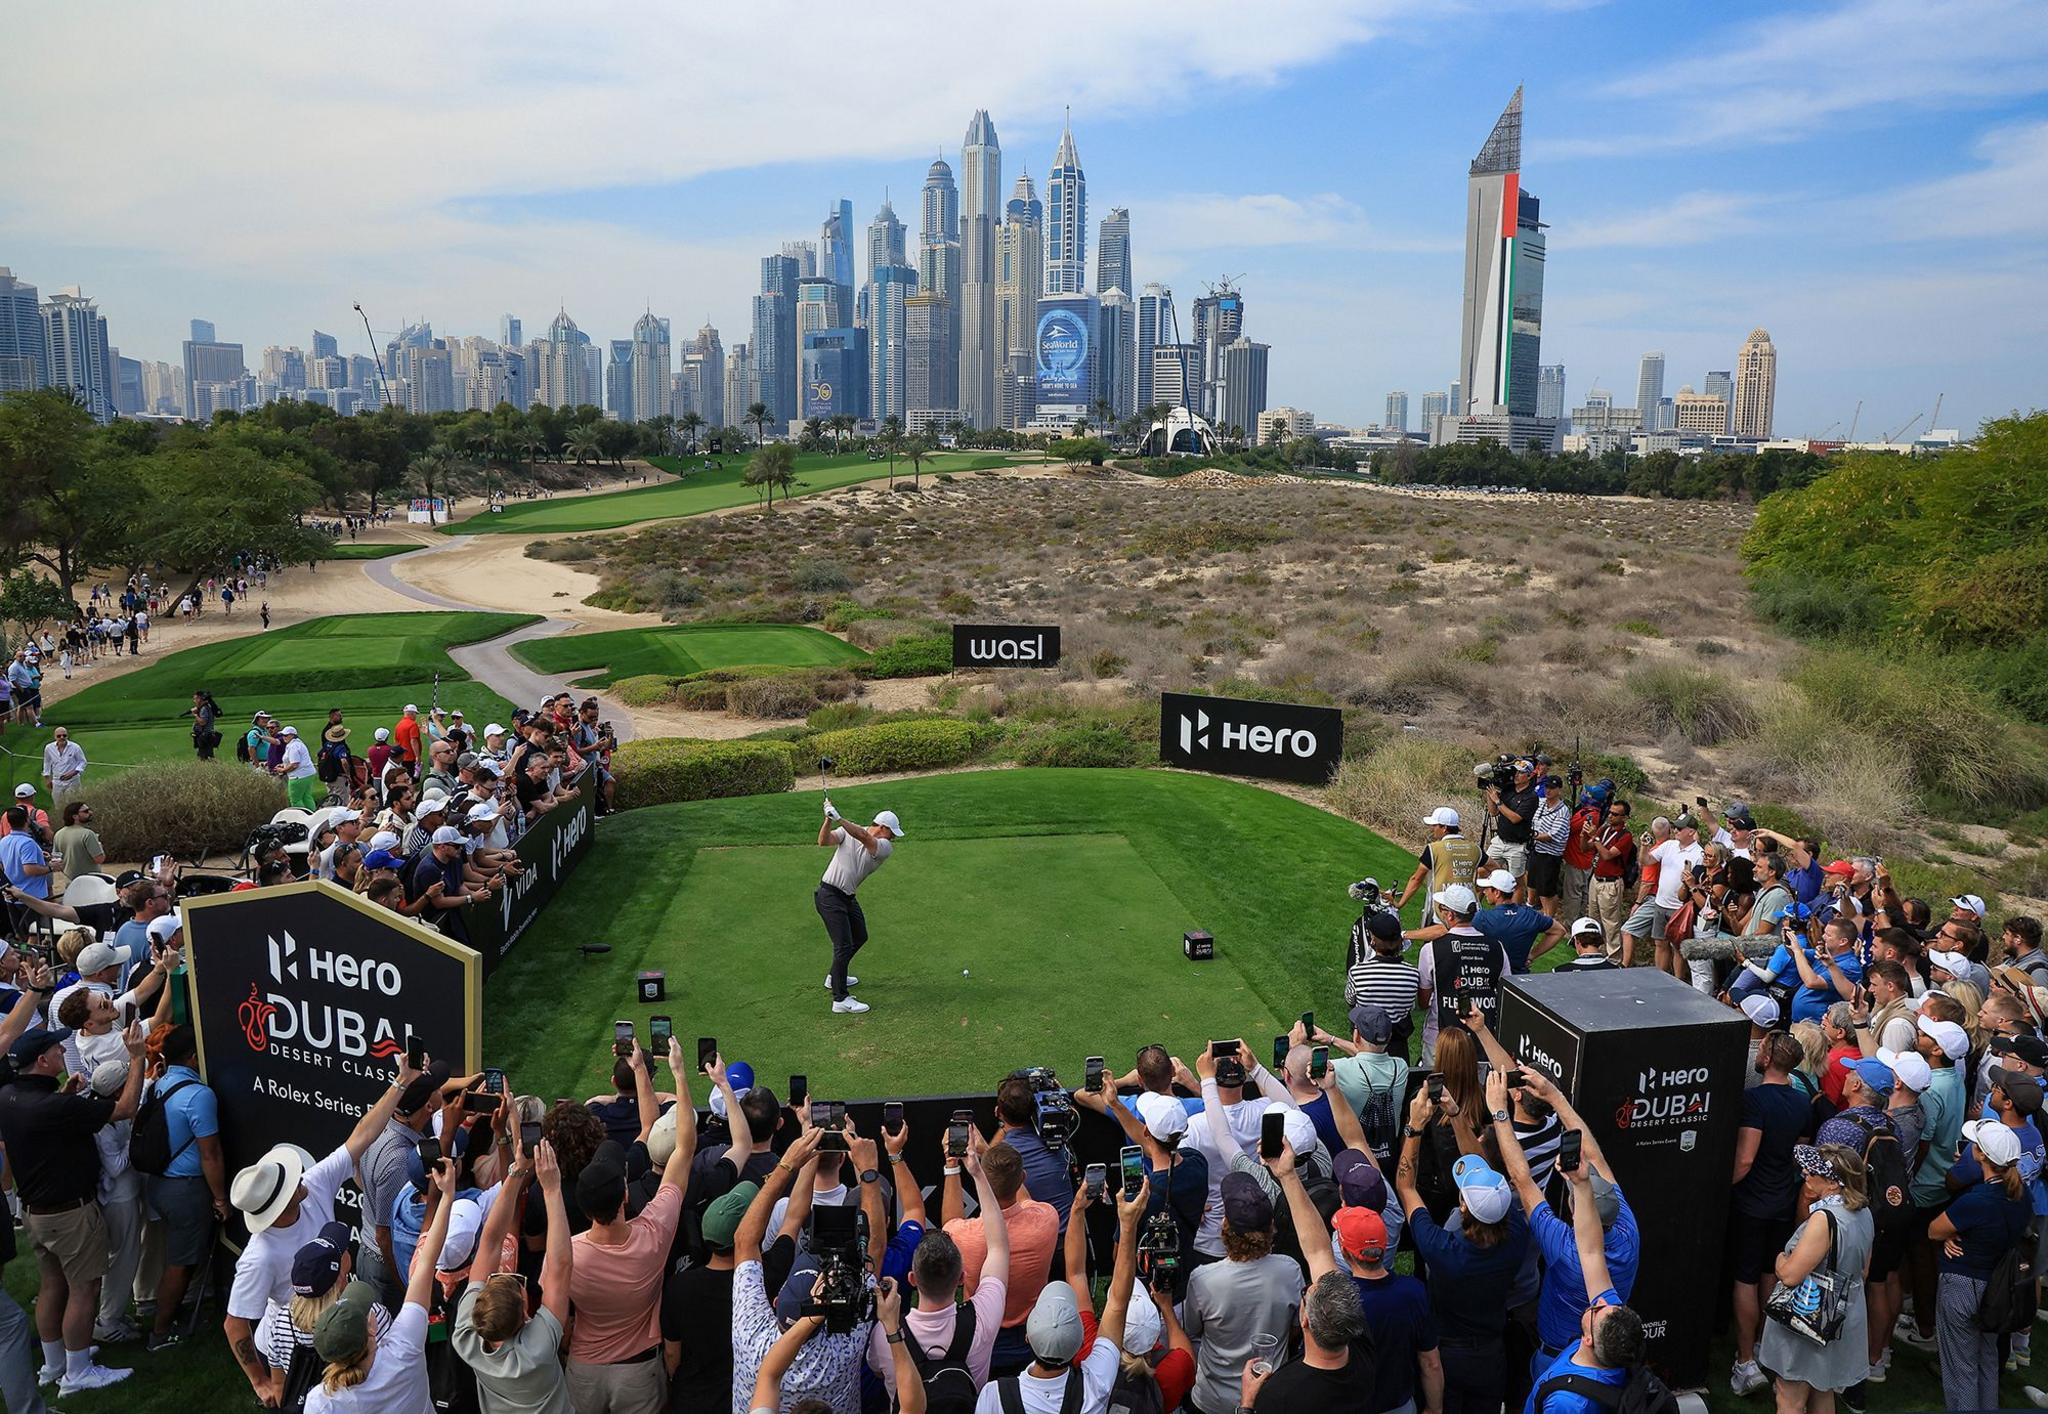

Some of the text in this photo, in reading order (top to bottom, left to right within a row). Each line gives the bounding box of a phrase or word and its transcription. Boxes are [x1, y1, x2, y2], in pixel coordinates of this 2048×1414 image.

[1042, 340, 1078, 350] SeaWorld
[811, 383, 832, 401] 50
[971, 634, 1043, 660] wasl
[1223, 722, 1317, 758] Hero
[563, 805, 588, 858] Hero
[516, 862, 539, 900] VIDA
[309, 947, 402, 996] Hero
[1442, 996, 1496, 1009] FLEWOO
[270, 1043, 398, 1086] DESERT CLASS
[1532, 1045, 1562, 1079] Hero
[1661, 1067, 1709, 1087] Hero
[253, 1076, 265, 1094] A
[268, 1078, 311, 1106] Rolex
[314, 1090, 362, 1118] Series
[1632, 1092, 1711, 1120] DUBAI
[1630, 1114, 1708, 1128] DESERT CLASSIC
[1640, 1320, 1668, 1329] WORLD
[1642, 1326, 1666, 1339] OUR
